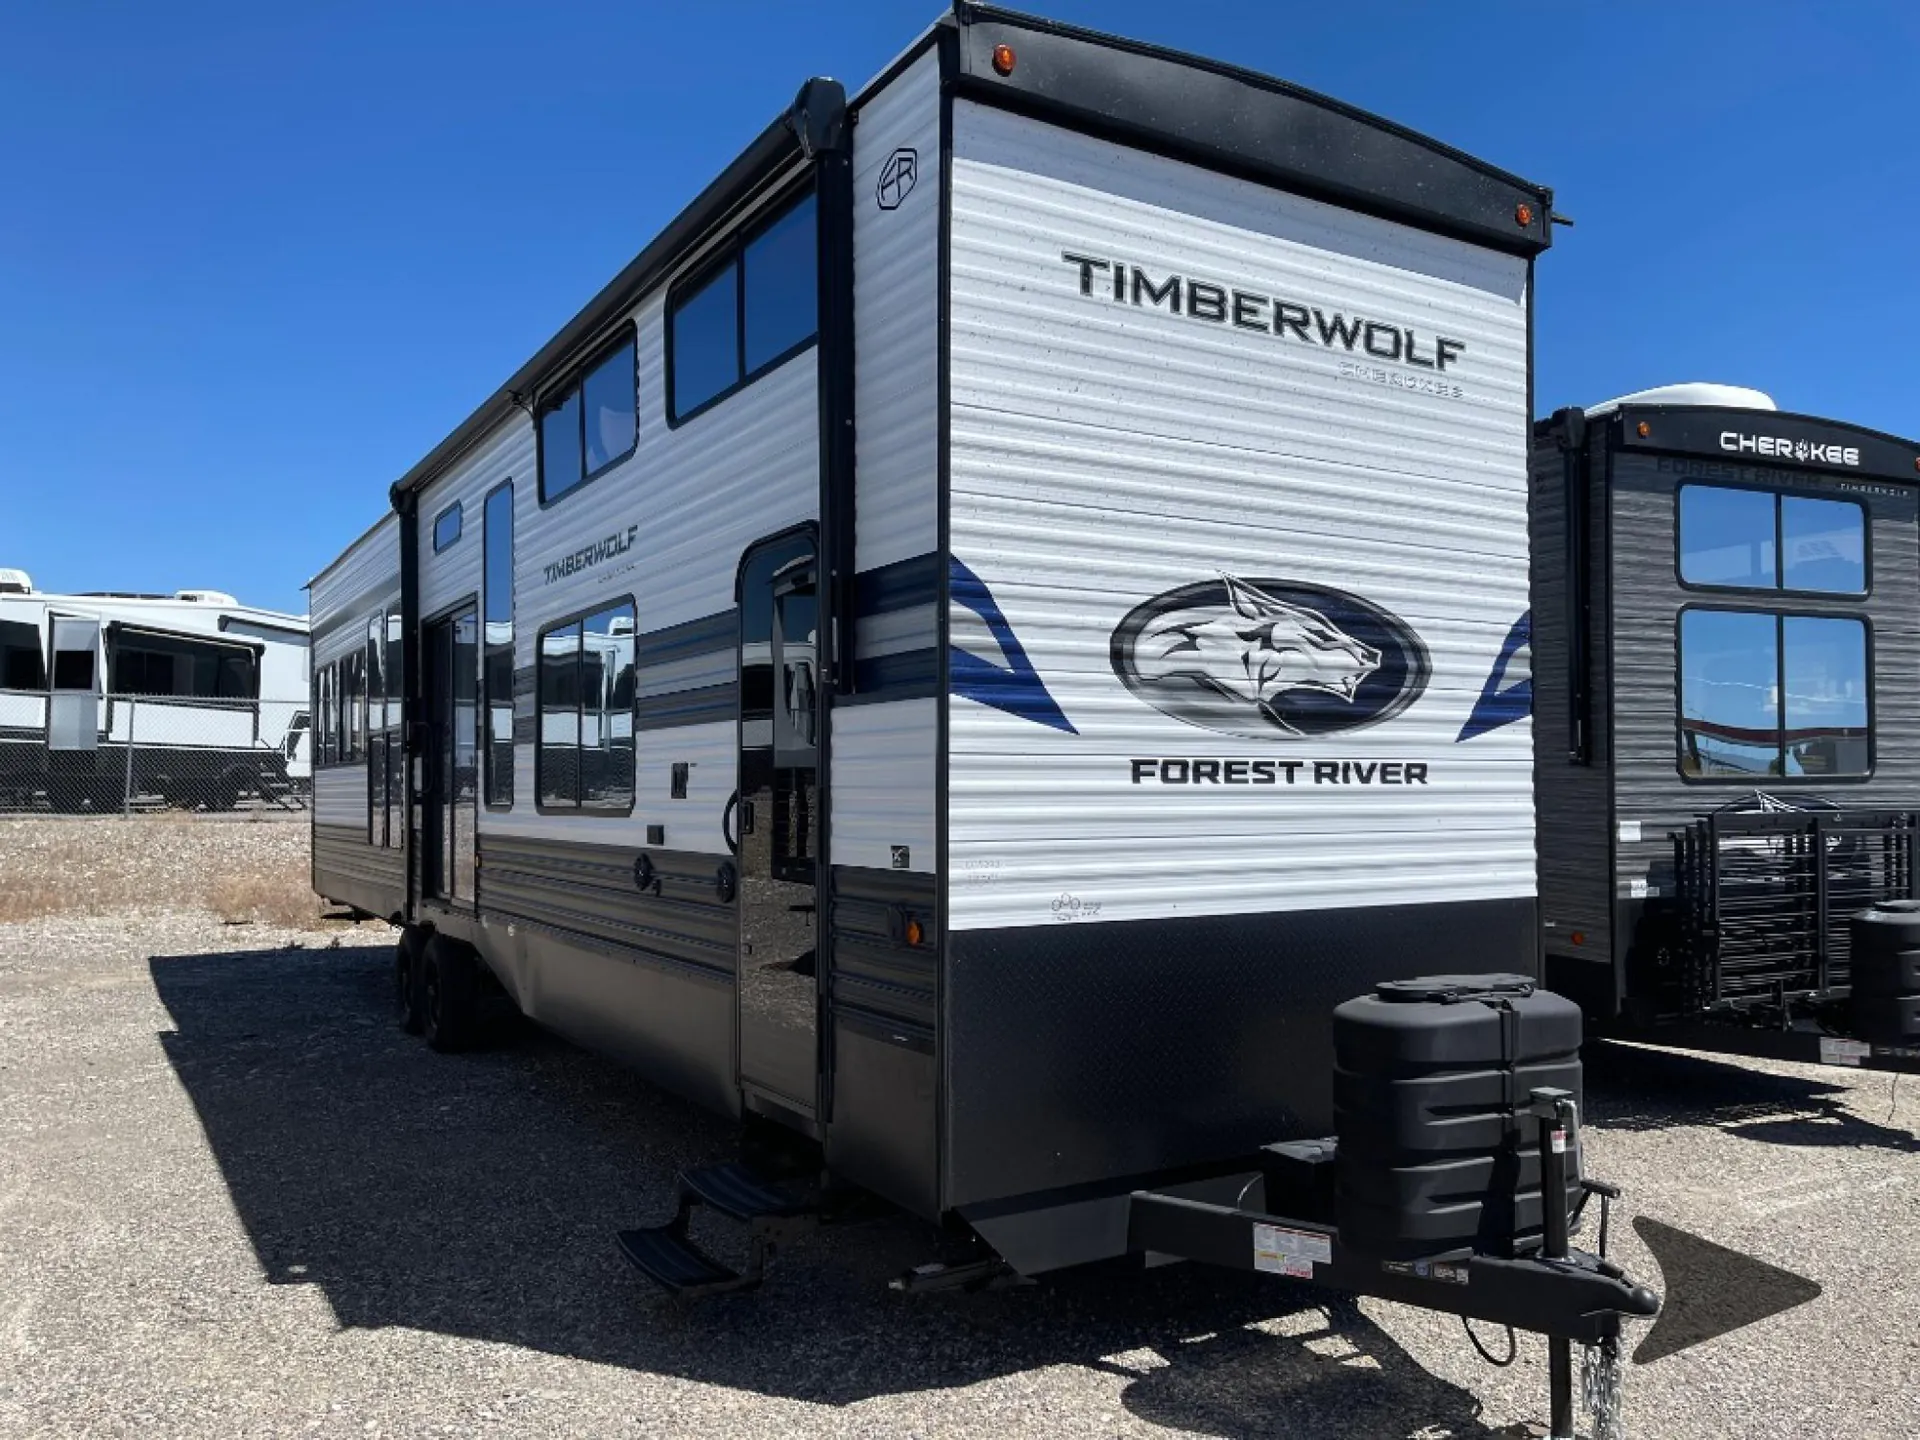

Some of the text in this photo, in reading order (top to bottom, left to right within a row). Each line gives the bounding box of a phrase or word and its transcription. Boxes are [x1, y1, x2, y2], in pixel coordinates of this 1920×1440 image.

[1062, 251, 1466, 371] TIMBERWOLF
[1719, 431, 1860, 466] CHEROKEE
[543, 525, 638, 586] TIMBERWOLF
[1130, 759, 1429, 785] FOREST RIVER
